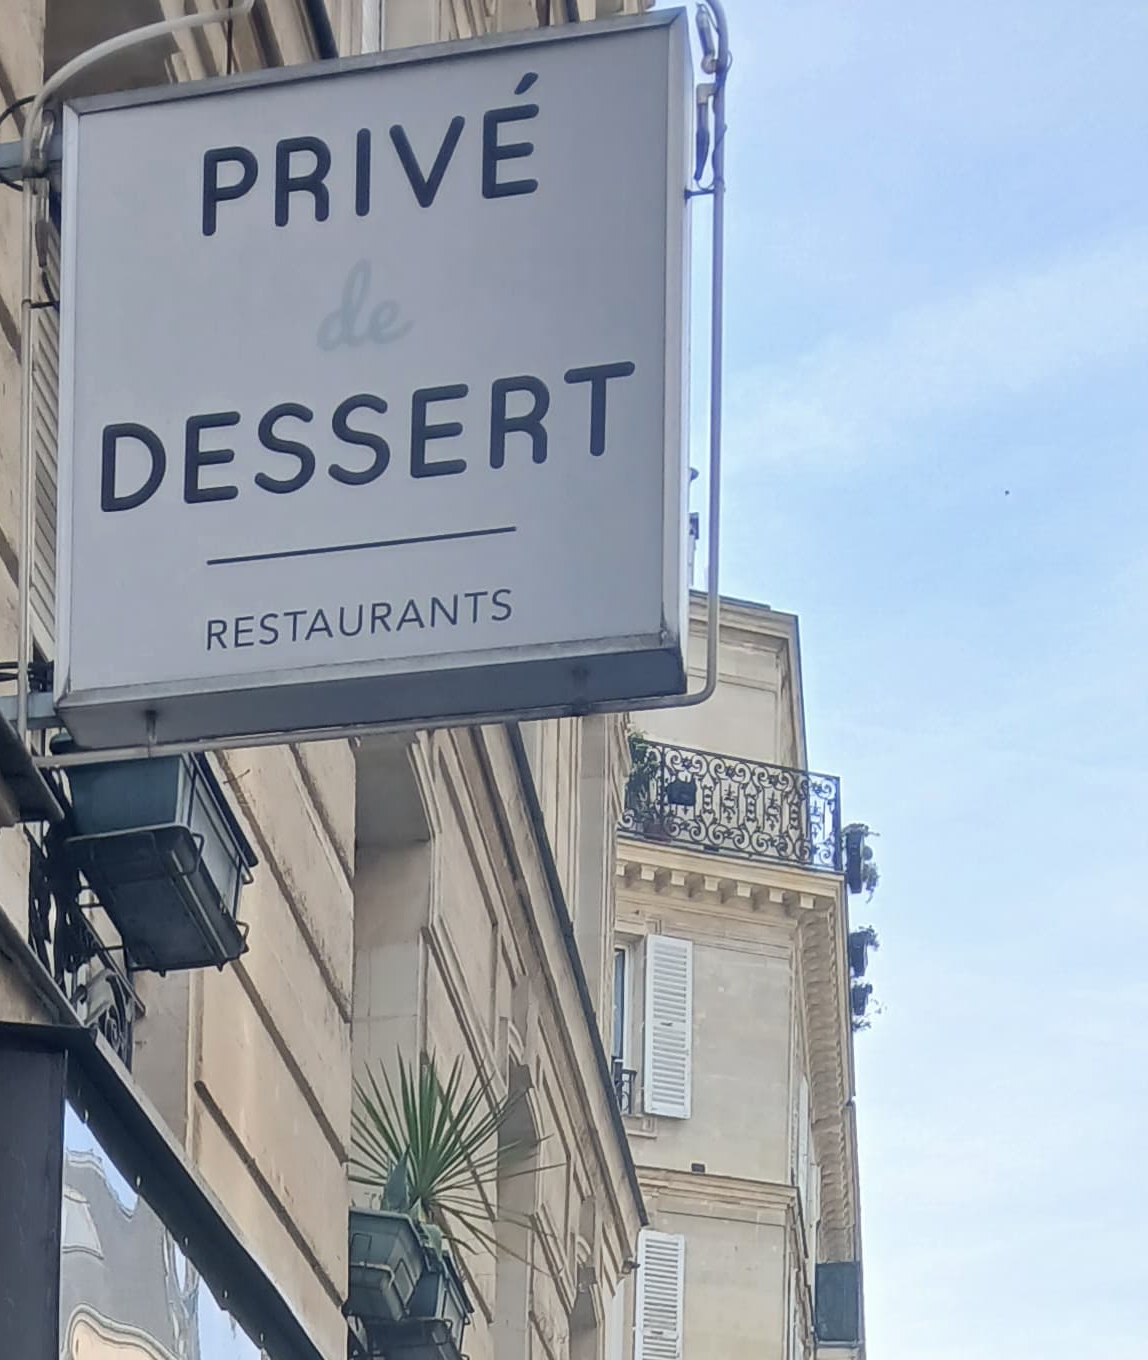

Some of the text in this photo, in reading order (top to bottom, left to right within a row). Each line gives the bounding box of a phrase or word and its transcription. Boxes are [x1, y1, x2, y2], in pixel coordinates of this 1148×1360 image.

[202, 72, 540, 237] PRIVÉ
[316, 260, 415, 352] de
[100, 361, 636, 512] DESSERT
[207, 587, 514, 651] RESTAURANTS
